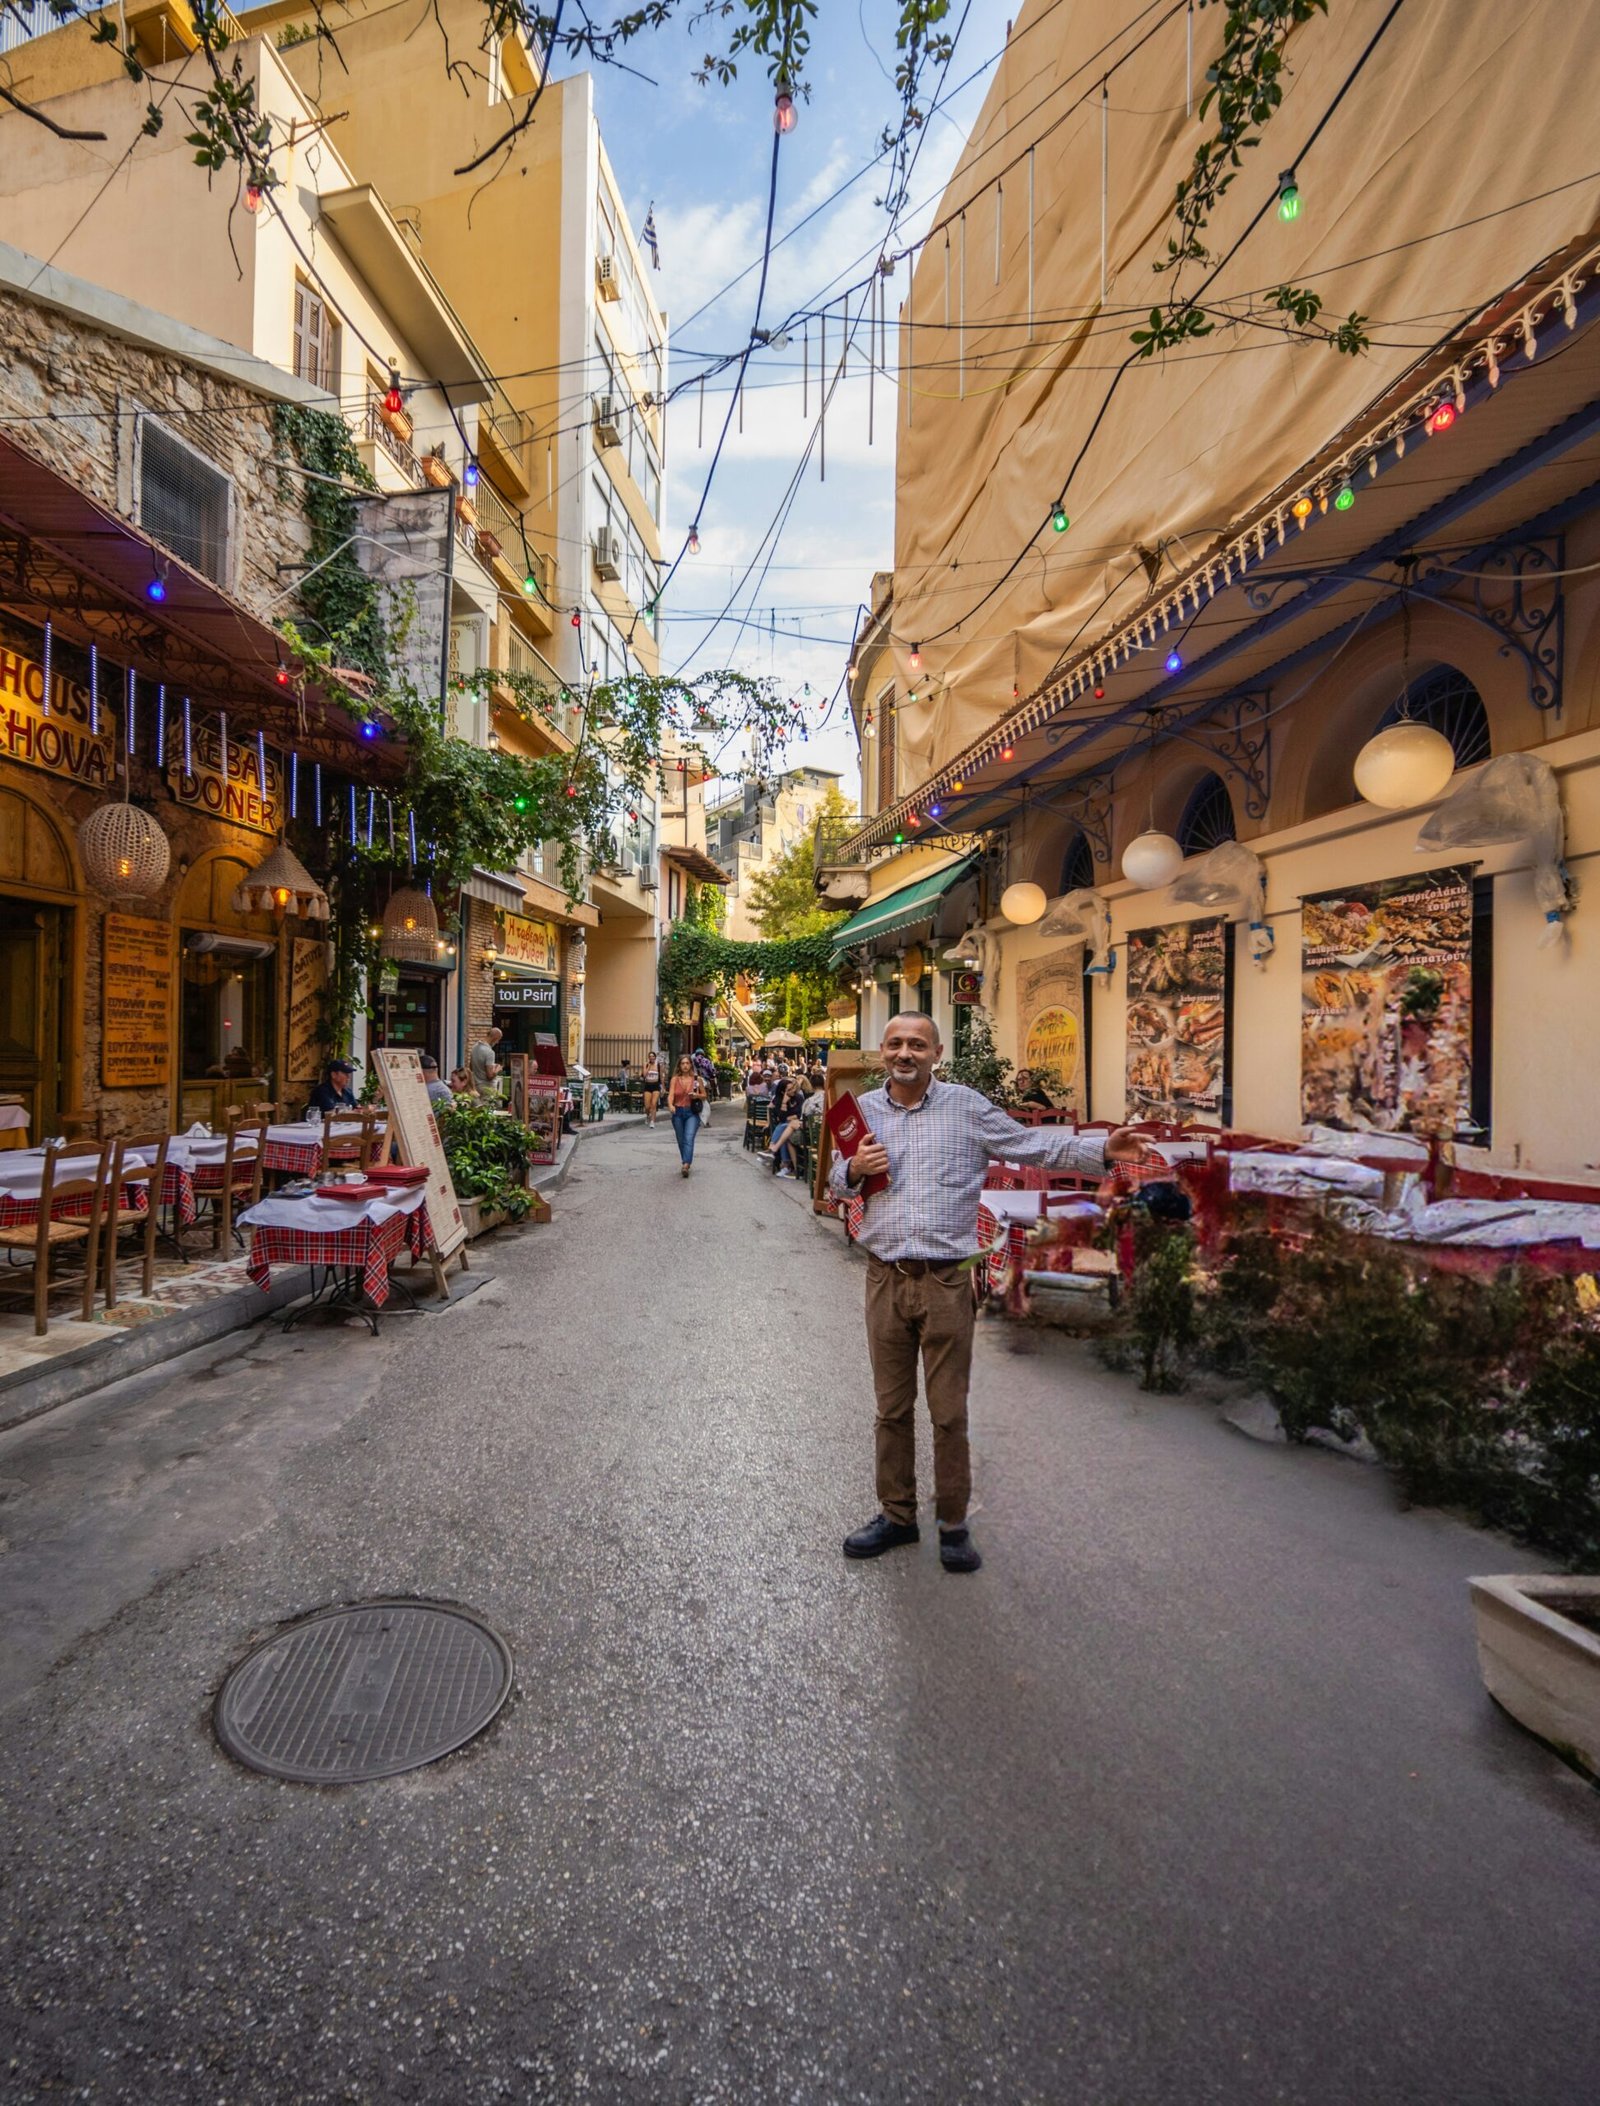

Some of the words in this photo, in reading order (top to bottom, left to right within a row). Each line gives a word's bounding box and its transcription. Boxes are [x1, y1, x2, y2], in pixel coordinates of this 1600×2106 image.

[0, 704, 107, 786] HOVA
[191, 726, 278, 793] KEBAB
[180, 766, 277, 831] DONER
[498, 988, 520, 1001] tou
